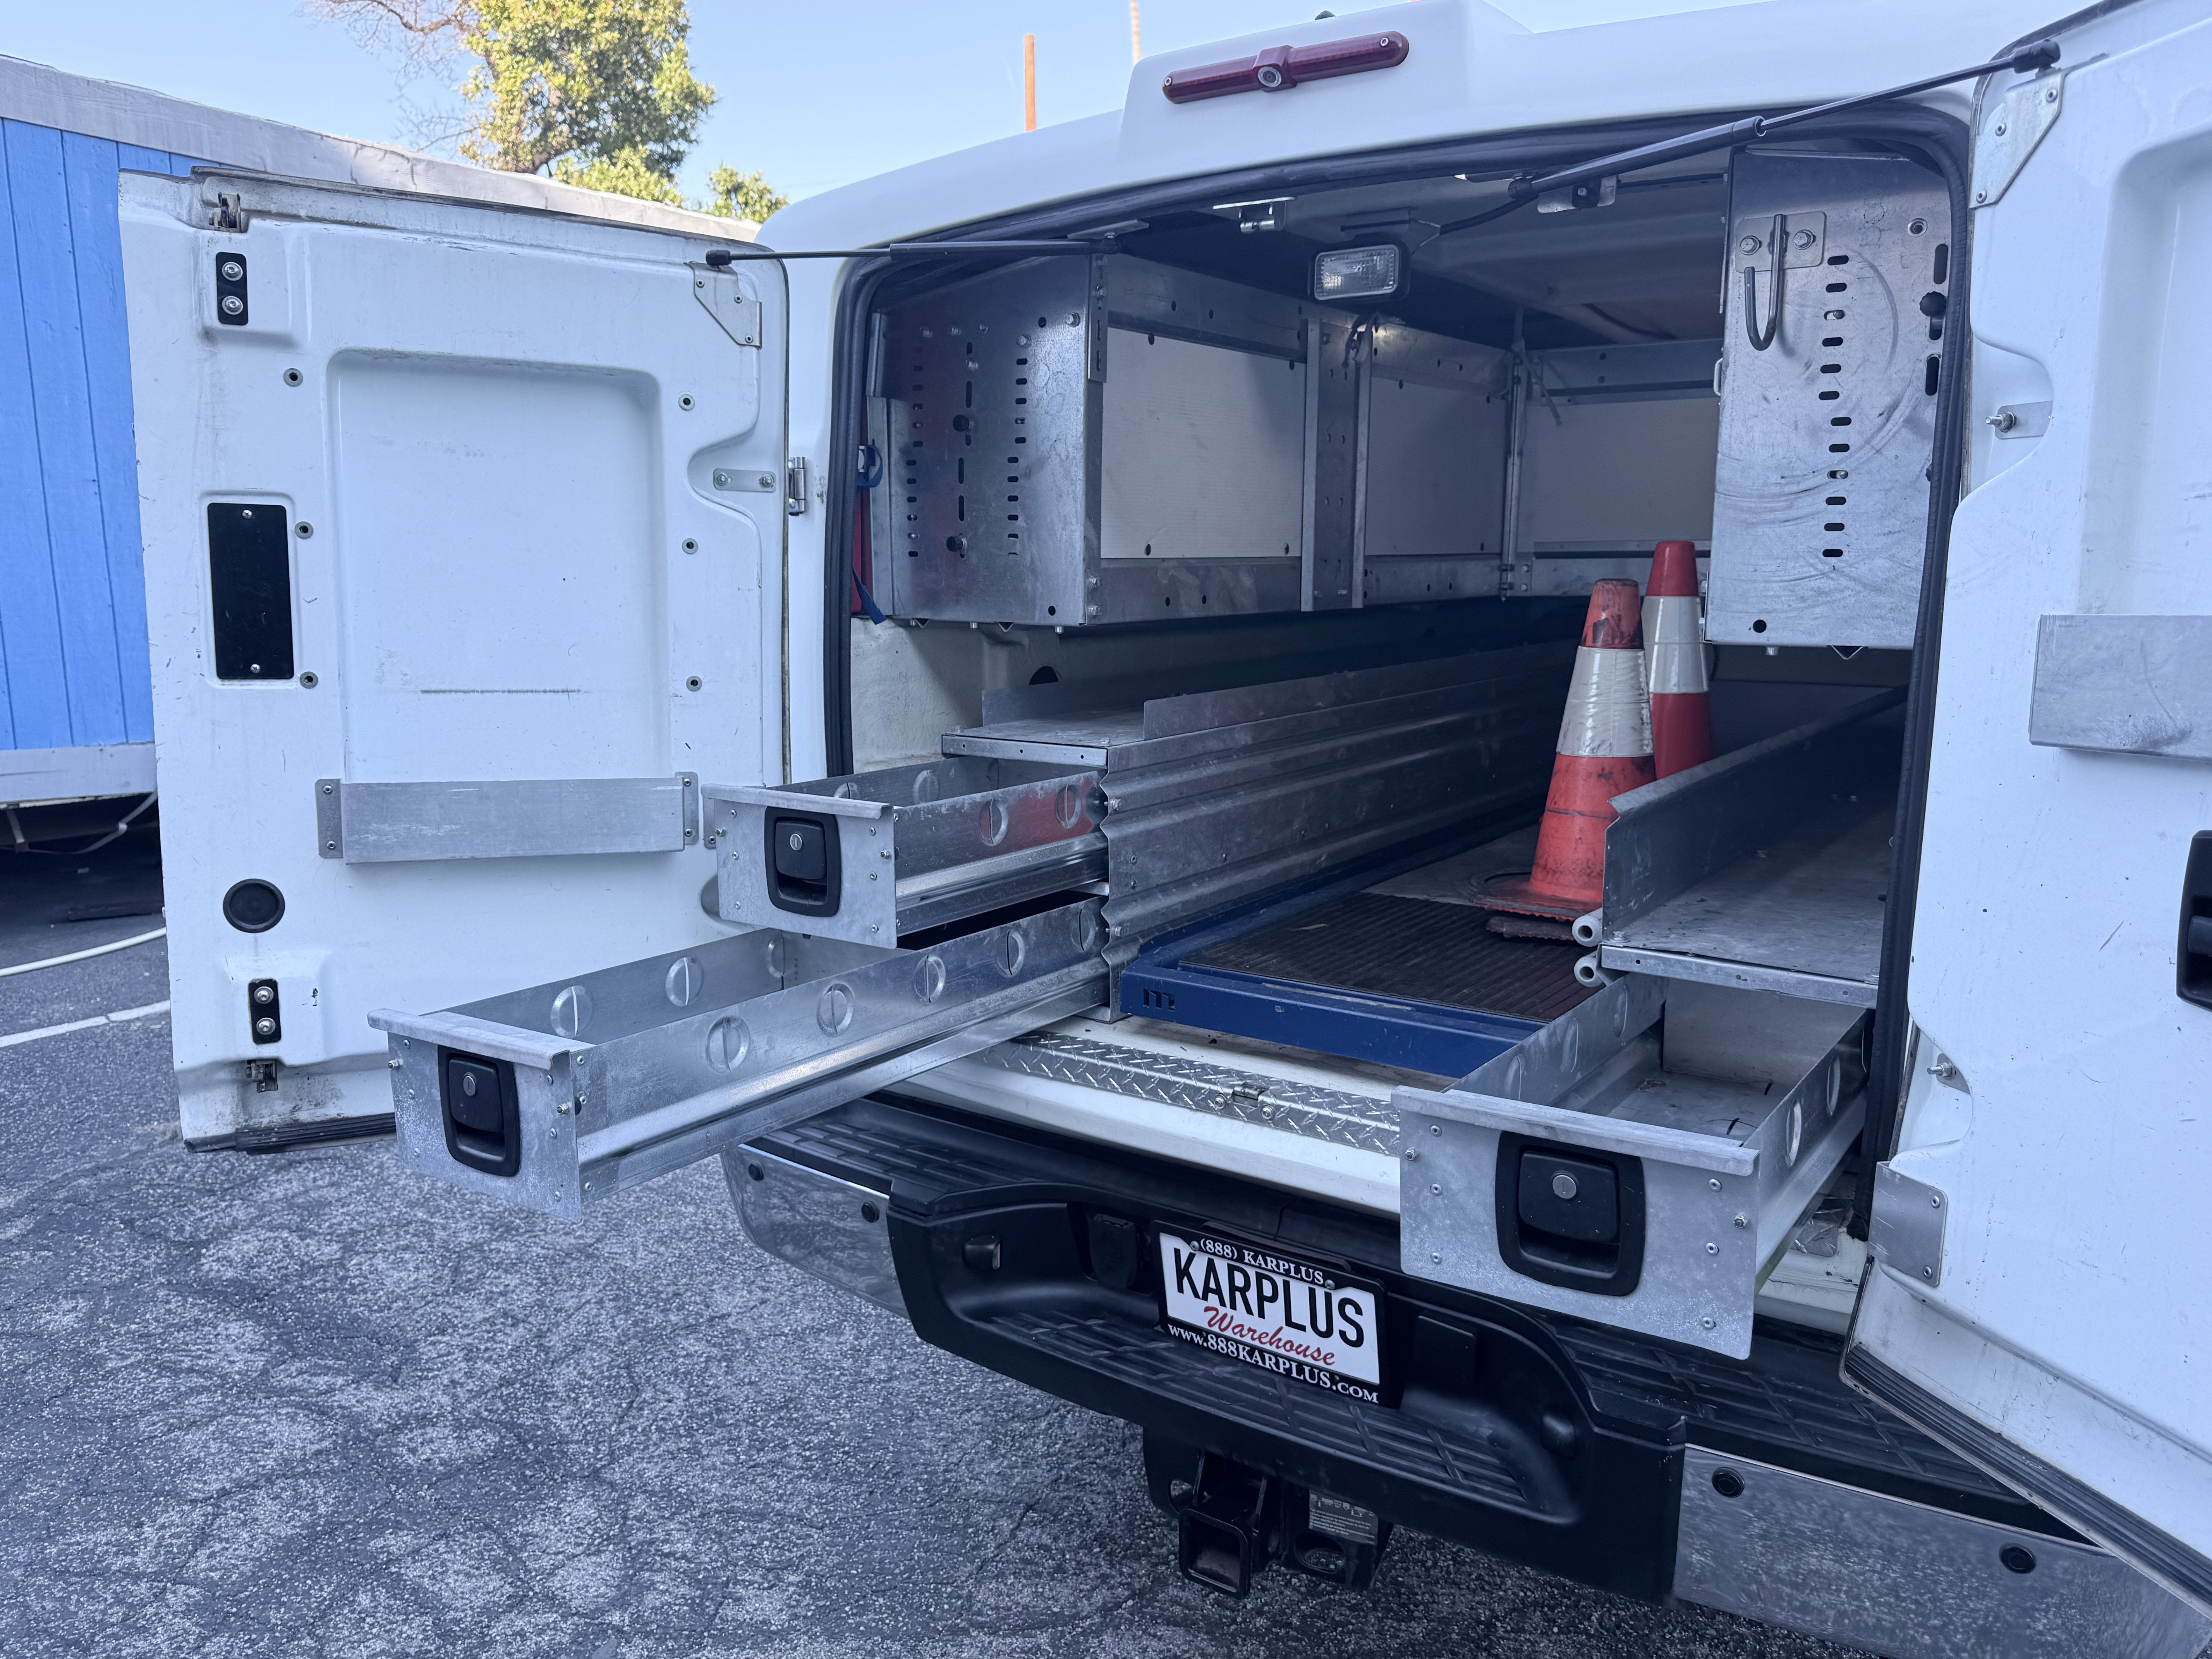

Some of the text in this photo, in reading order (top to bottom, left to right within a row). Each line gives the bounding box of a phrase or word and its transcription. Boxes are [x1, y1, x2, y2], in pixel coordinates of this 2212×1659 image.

[1201, 1238, 1324, 1284] (888) KARPLUS
[1174, 1248, 1364, 1348] KARPLUS
[1204, 1306, 1335, 1365] Warehouse
